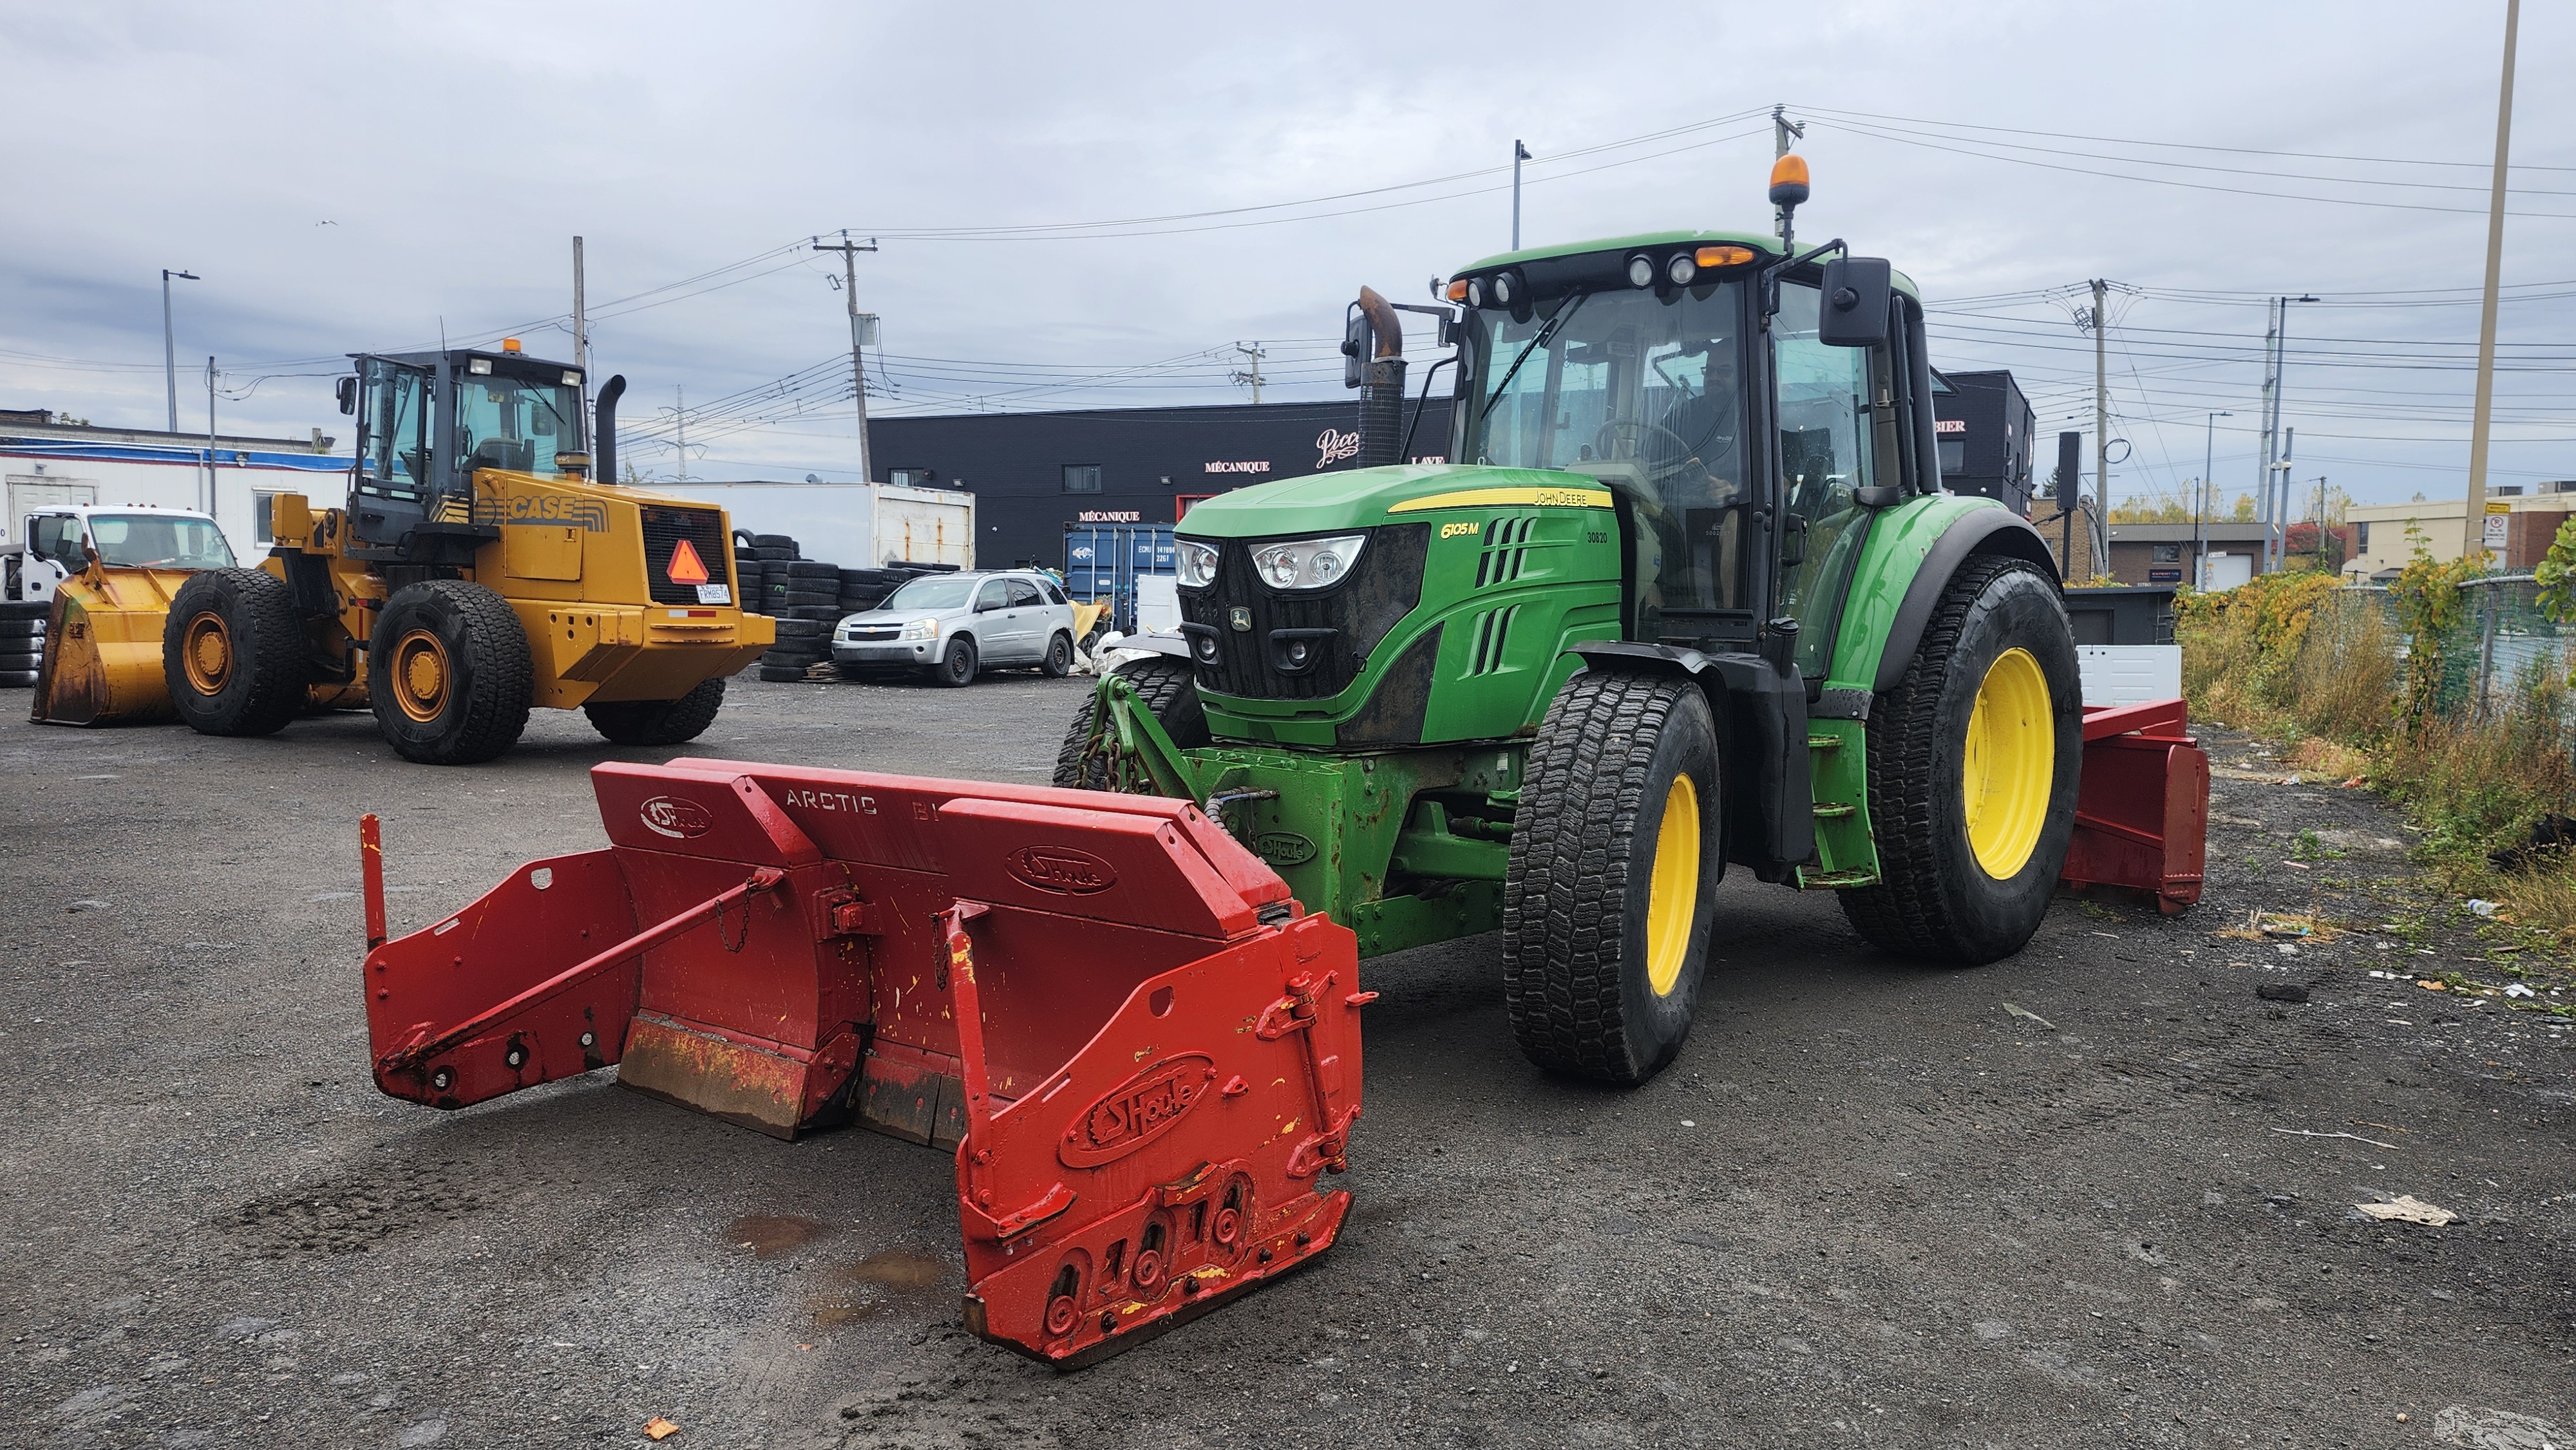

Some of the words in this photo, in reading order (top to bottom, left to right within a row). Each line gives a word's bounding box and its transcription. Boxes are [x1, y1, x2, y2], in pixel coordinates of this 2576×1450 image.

[1316, 429, 1359, 469] Picc
[1205, 460, 1270, 474] MÉCANIQUE
[1535, 491, 1558, 505] JOHN
[1559, 491, 1589, 507] DEERE
[509, 496, 576, 520] CASE
[1079, 510, 1140, 523] MÉCANIQUE
[1587, 532, 1607, 543] 30820
[699, 589, 728, 599] FRM8574
[787, 789, 877, 814] ARCTIC
